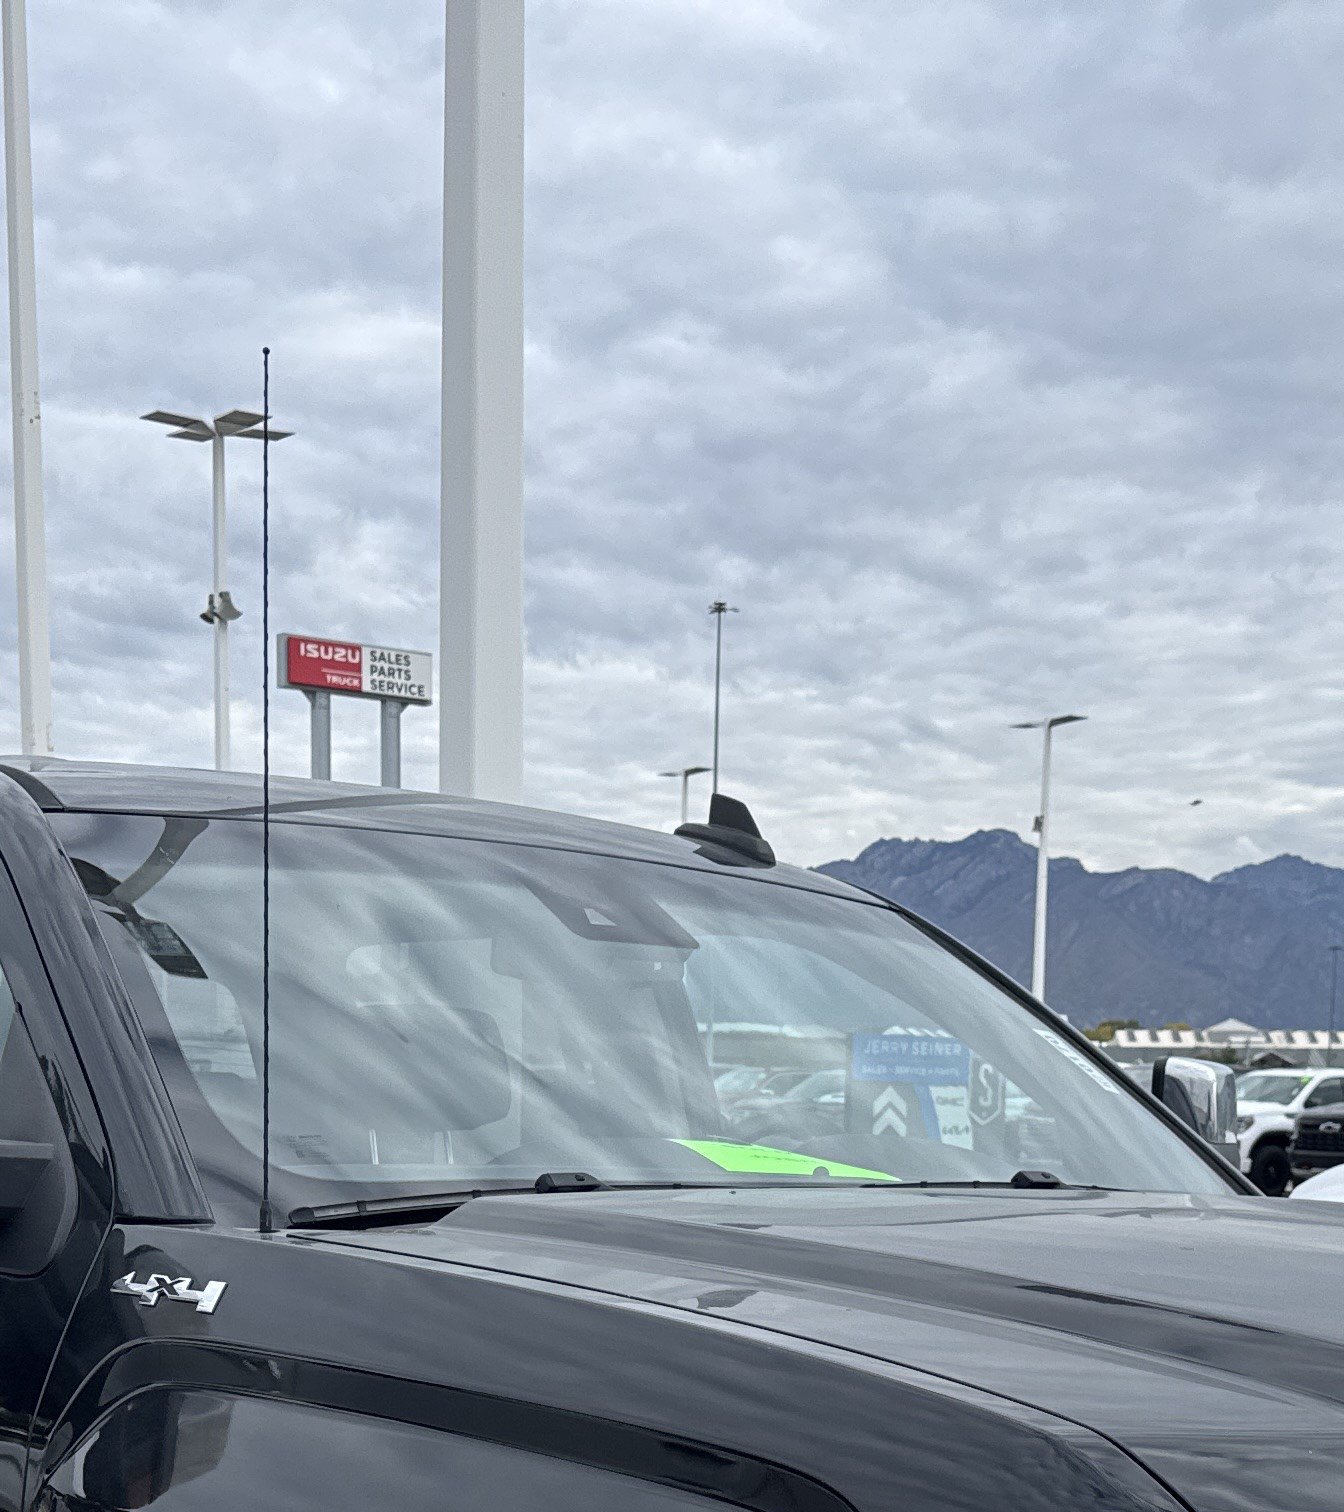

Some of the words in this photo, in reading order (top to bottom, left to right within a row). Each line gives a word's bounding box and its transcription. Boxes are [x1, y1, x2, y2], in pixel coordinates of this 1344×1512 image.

[299, 642, 360, 664] ISUZU
[370, 651, 411, 667] SALES
[326, 674, 360, 688] TRUCK
[370, 666, 411, 681] PARTS
[370, 680, 425, 697] SERVICE
[864, 1039, 908, 1054] JERRY
[912, 1041, 962, 1056] SEINER
